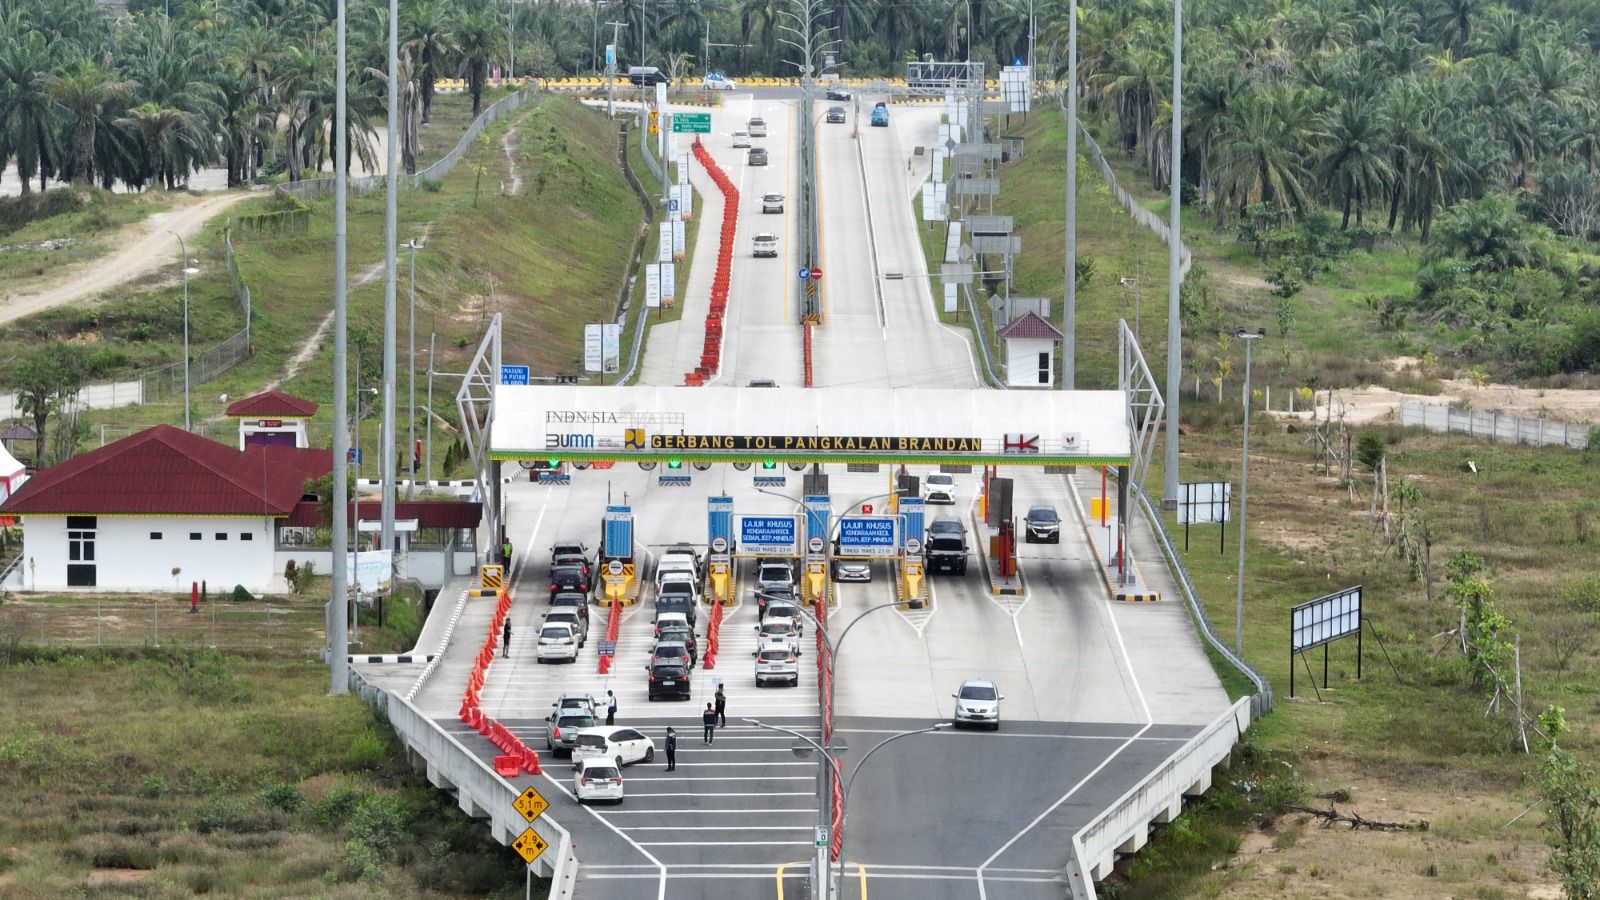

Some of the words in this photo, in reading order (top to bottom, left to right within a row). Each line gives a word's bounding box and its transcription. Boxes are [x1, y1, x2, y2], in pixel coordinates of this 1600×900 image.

[652, 436, 734, 448] GERBANG
[744, 436, 776, 449] TOL
[784, 437, 890, 450] PANGKALAN
[898, 438, 981, 450] BRANDAN
